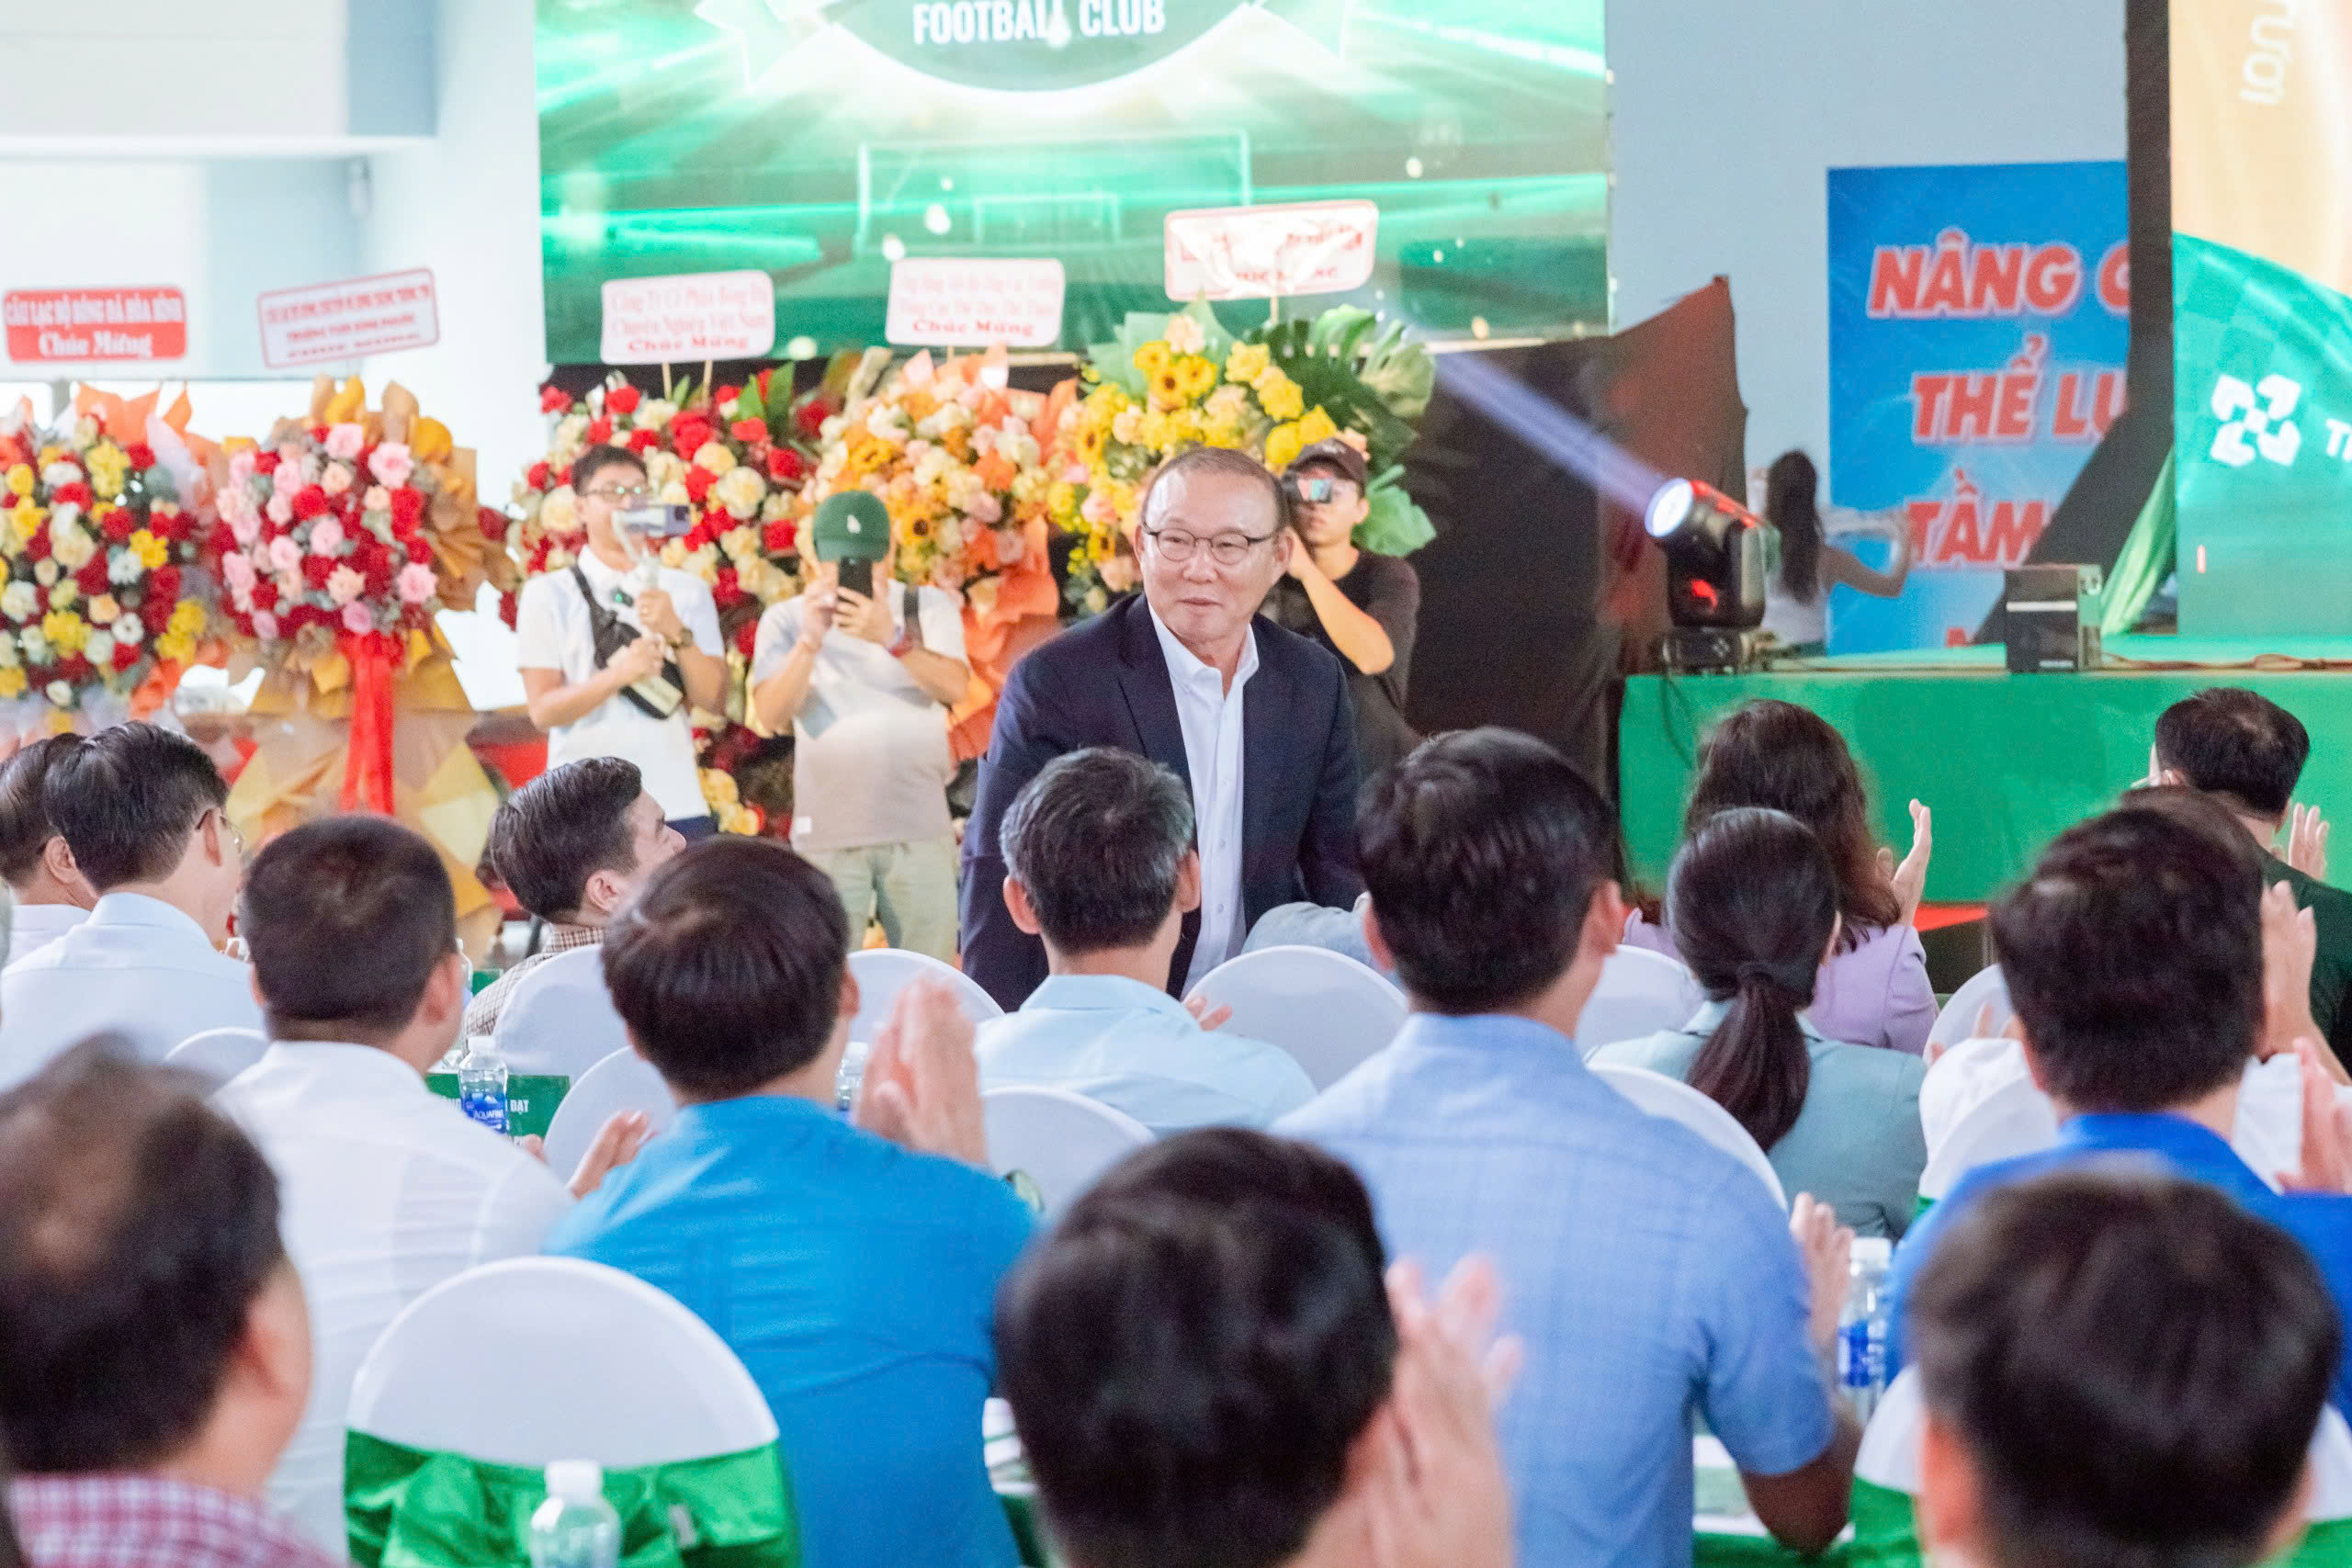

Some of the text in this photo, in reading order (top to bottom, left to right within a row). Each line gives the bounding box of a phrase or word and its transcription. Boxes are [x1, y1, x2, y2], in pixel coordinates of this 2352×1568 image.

[1079, 0, 1166, 37] CLUB
[1869, 227, 2082, 318] NÂNG
[1914, 335, 2048, 444] THỂ
[2325, 418, 2352, 462] T
[1905, 468, 2055, 568] TẦM
